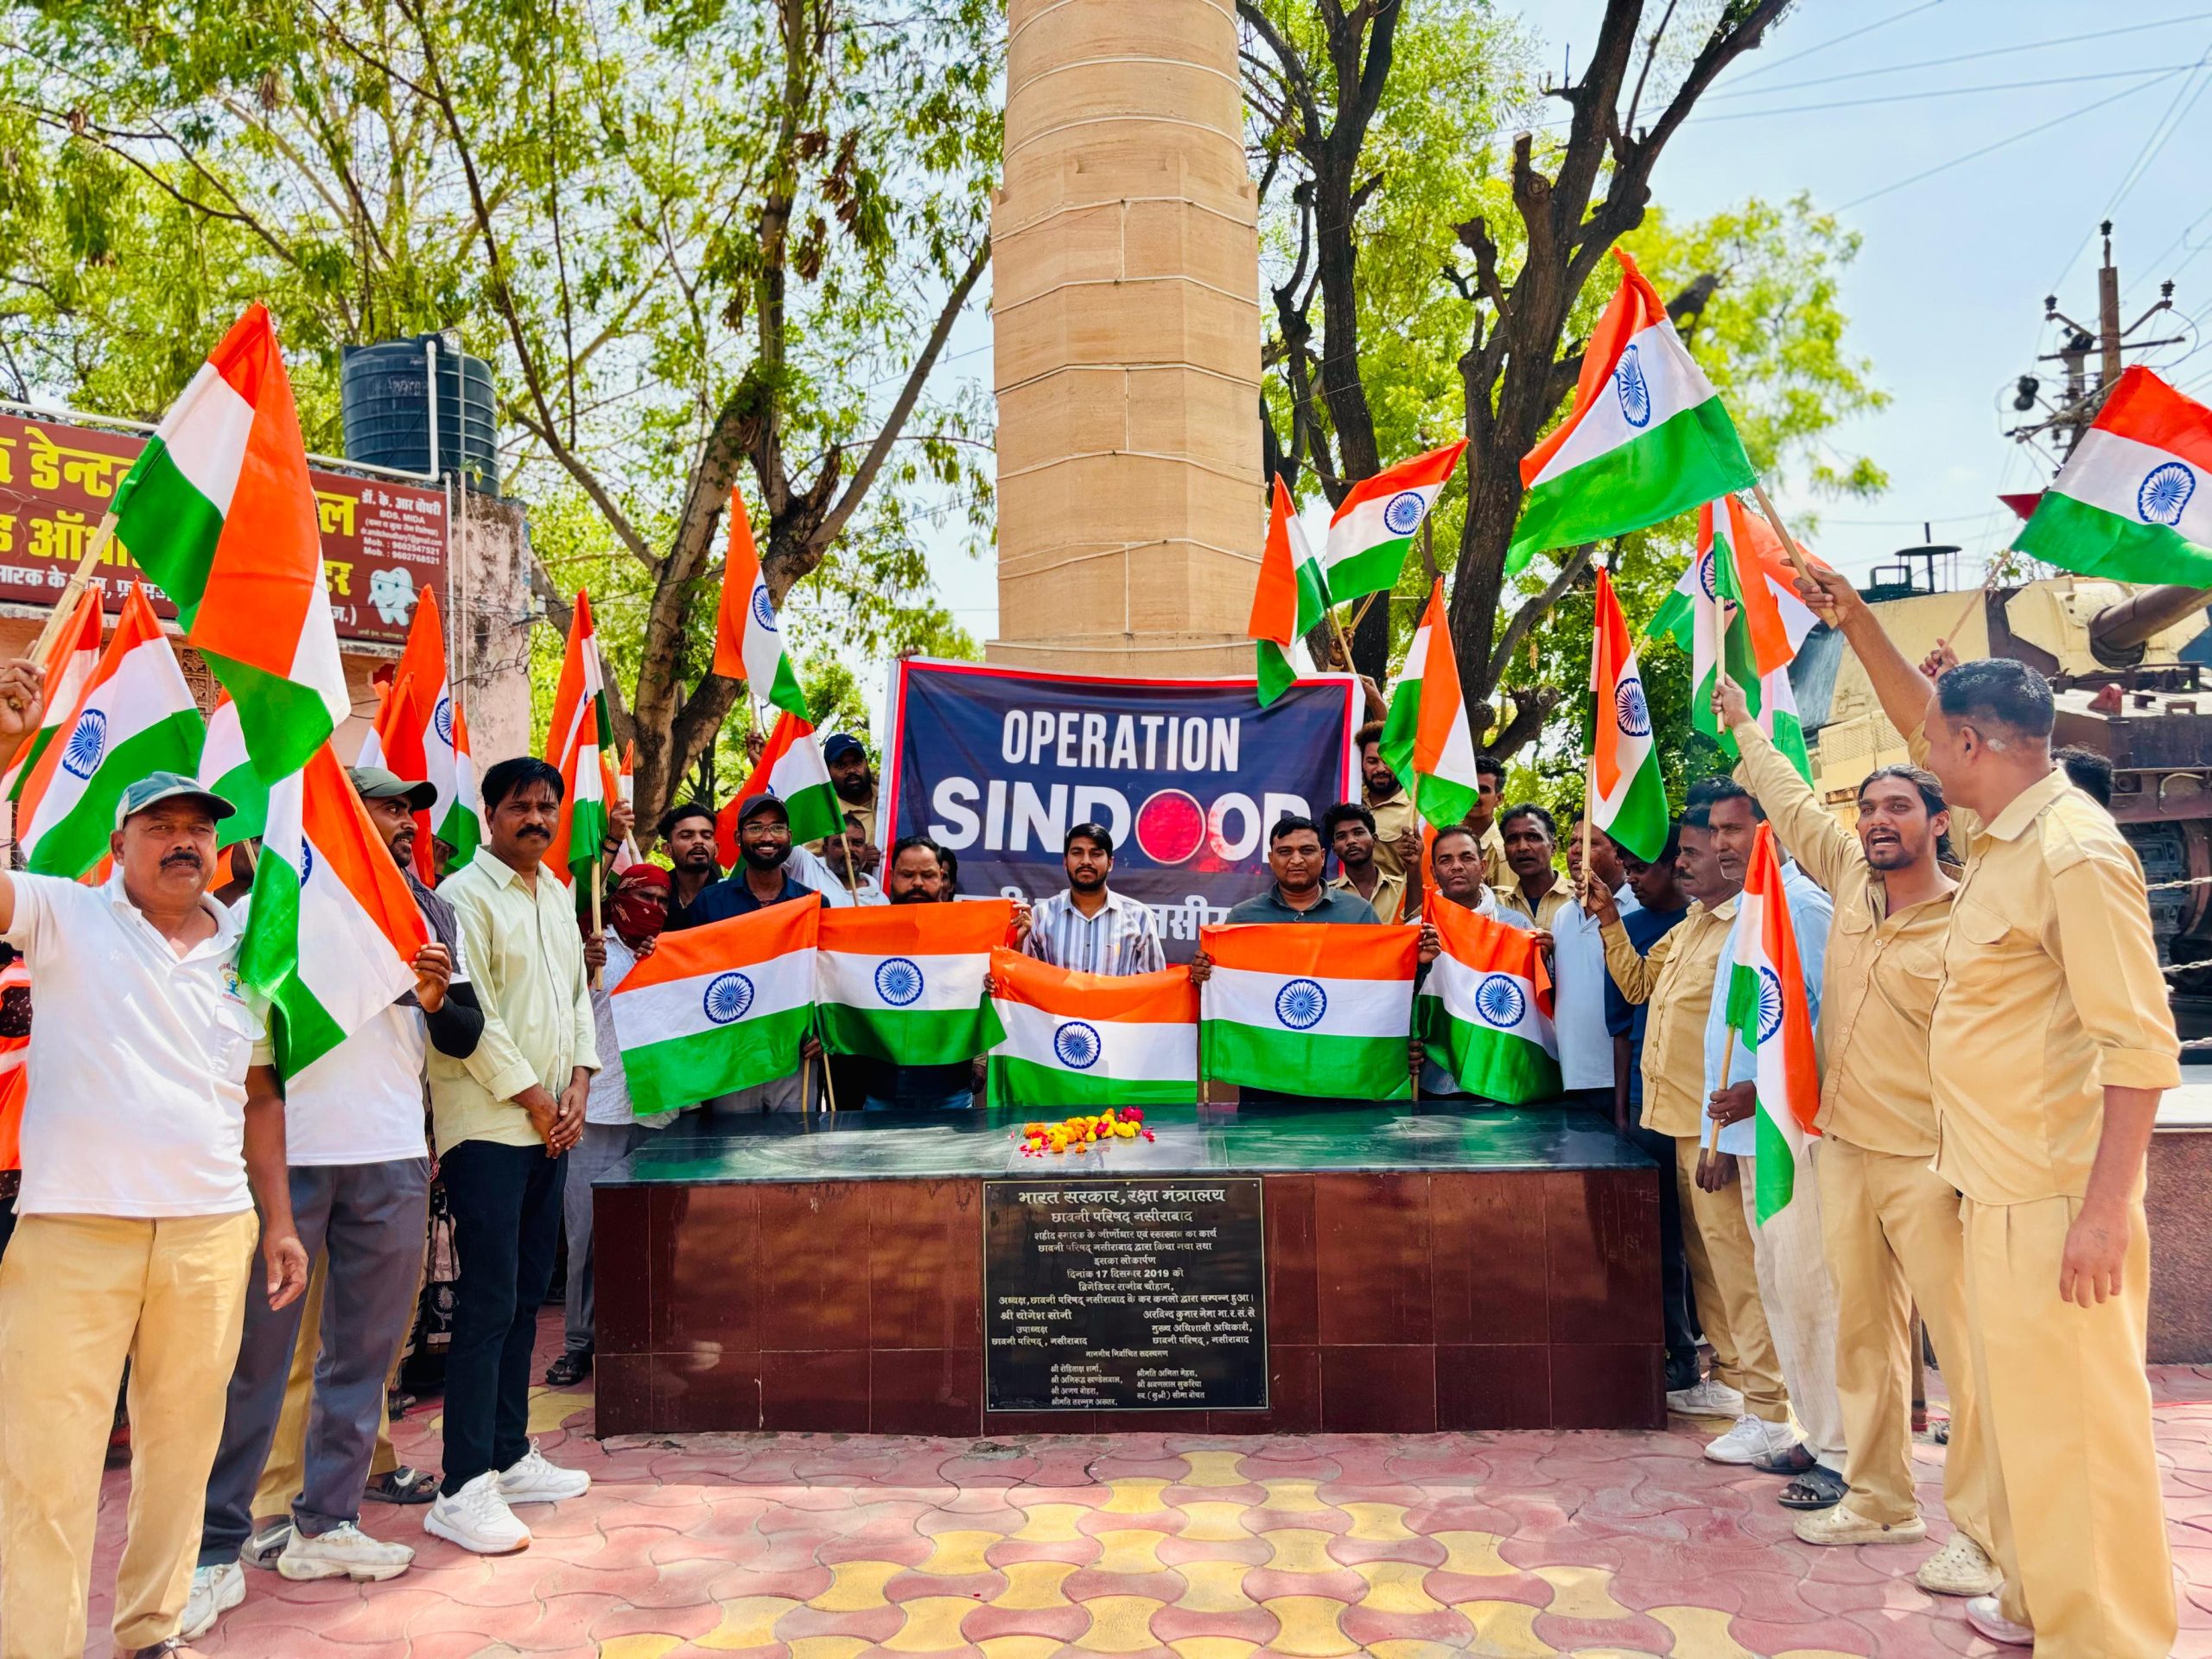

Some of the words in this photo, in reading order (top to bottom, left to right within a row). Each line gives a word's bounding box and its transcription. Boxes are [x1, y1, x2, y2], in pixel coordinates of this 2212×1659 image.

[25, 426, 139, 499] डेन्ट
[1001, 709, 1241, 772] OPERATION
[1019, 1192, 1059, 1204] भारत
[1127, 1190, 1159, 1205] रक्षा
[1162, 1185, 1225, 1202] मंत्रालय
[1051, 1208, 1090, 1223] छावनी
[1093, 1208, 1134, 1225] परिषद्
[1134, 1207, 1193, 1222] नसीराबाद
[1038, 1242, 1064, 1252] छावनी
[1095, 1269, 1108, 1278] 17
[1143, 1268, 1170, 1278] 2019
